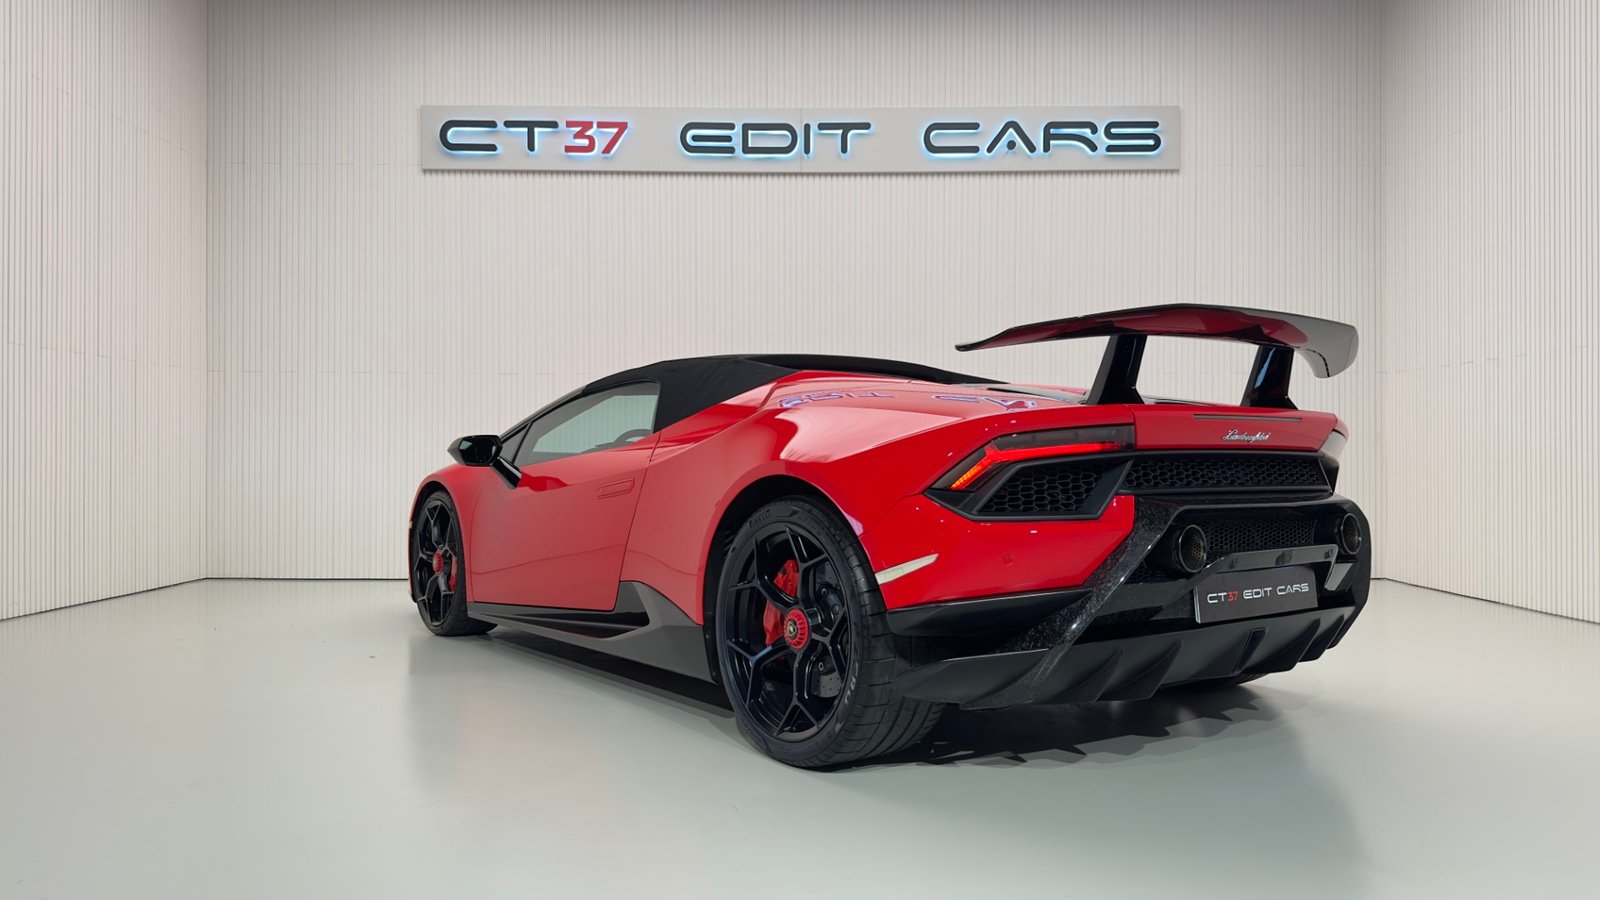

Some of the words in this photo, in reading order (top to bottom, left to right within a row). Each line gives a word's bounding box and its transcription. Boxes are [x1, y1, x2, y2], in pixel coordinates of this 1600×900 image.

[438, 119, 629, 155] CT37
[679, 121, 872, 156] EDIT
[922, 119, 1162, 155] CARS
[1206, 591, 1239, 604] CT37
[1242, 587, 1273, 600] EDIT
[1276, 582, 1310, 595] CARS
